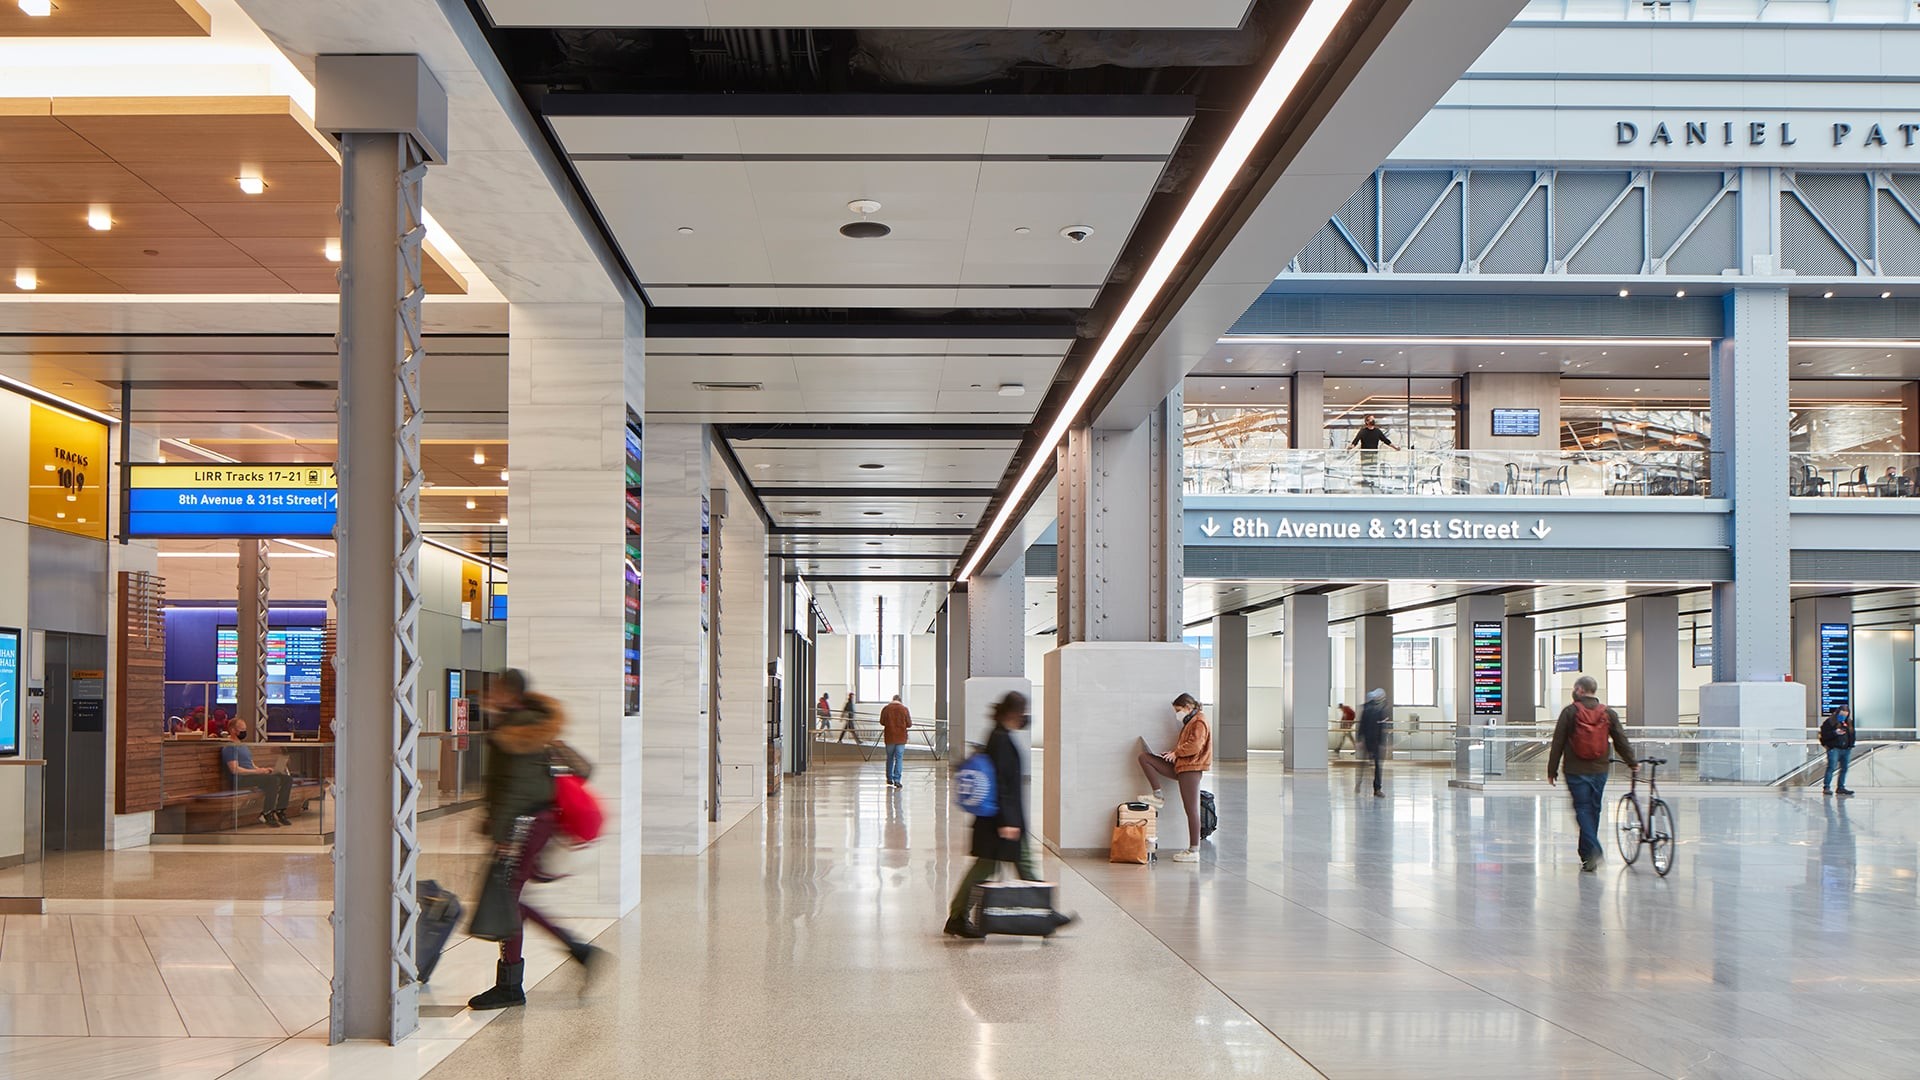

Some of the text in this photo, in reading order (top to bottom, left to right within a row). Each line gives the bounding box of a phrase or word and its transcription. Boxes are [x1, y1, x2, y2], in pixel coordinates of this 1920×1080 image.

[1616, 121, 1920, 147] DANIEL PAT
[54, 447, 89, 467] TRACKS
[194, 471, 222, 482] LIRR
[227, 471, 265, 482] Tracks
[178, 494, 323, 506] 8th Avenue & 31st Street
[1232, 517, 1520, 540] 8th Avenue & 31st Street
